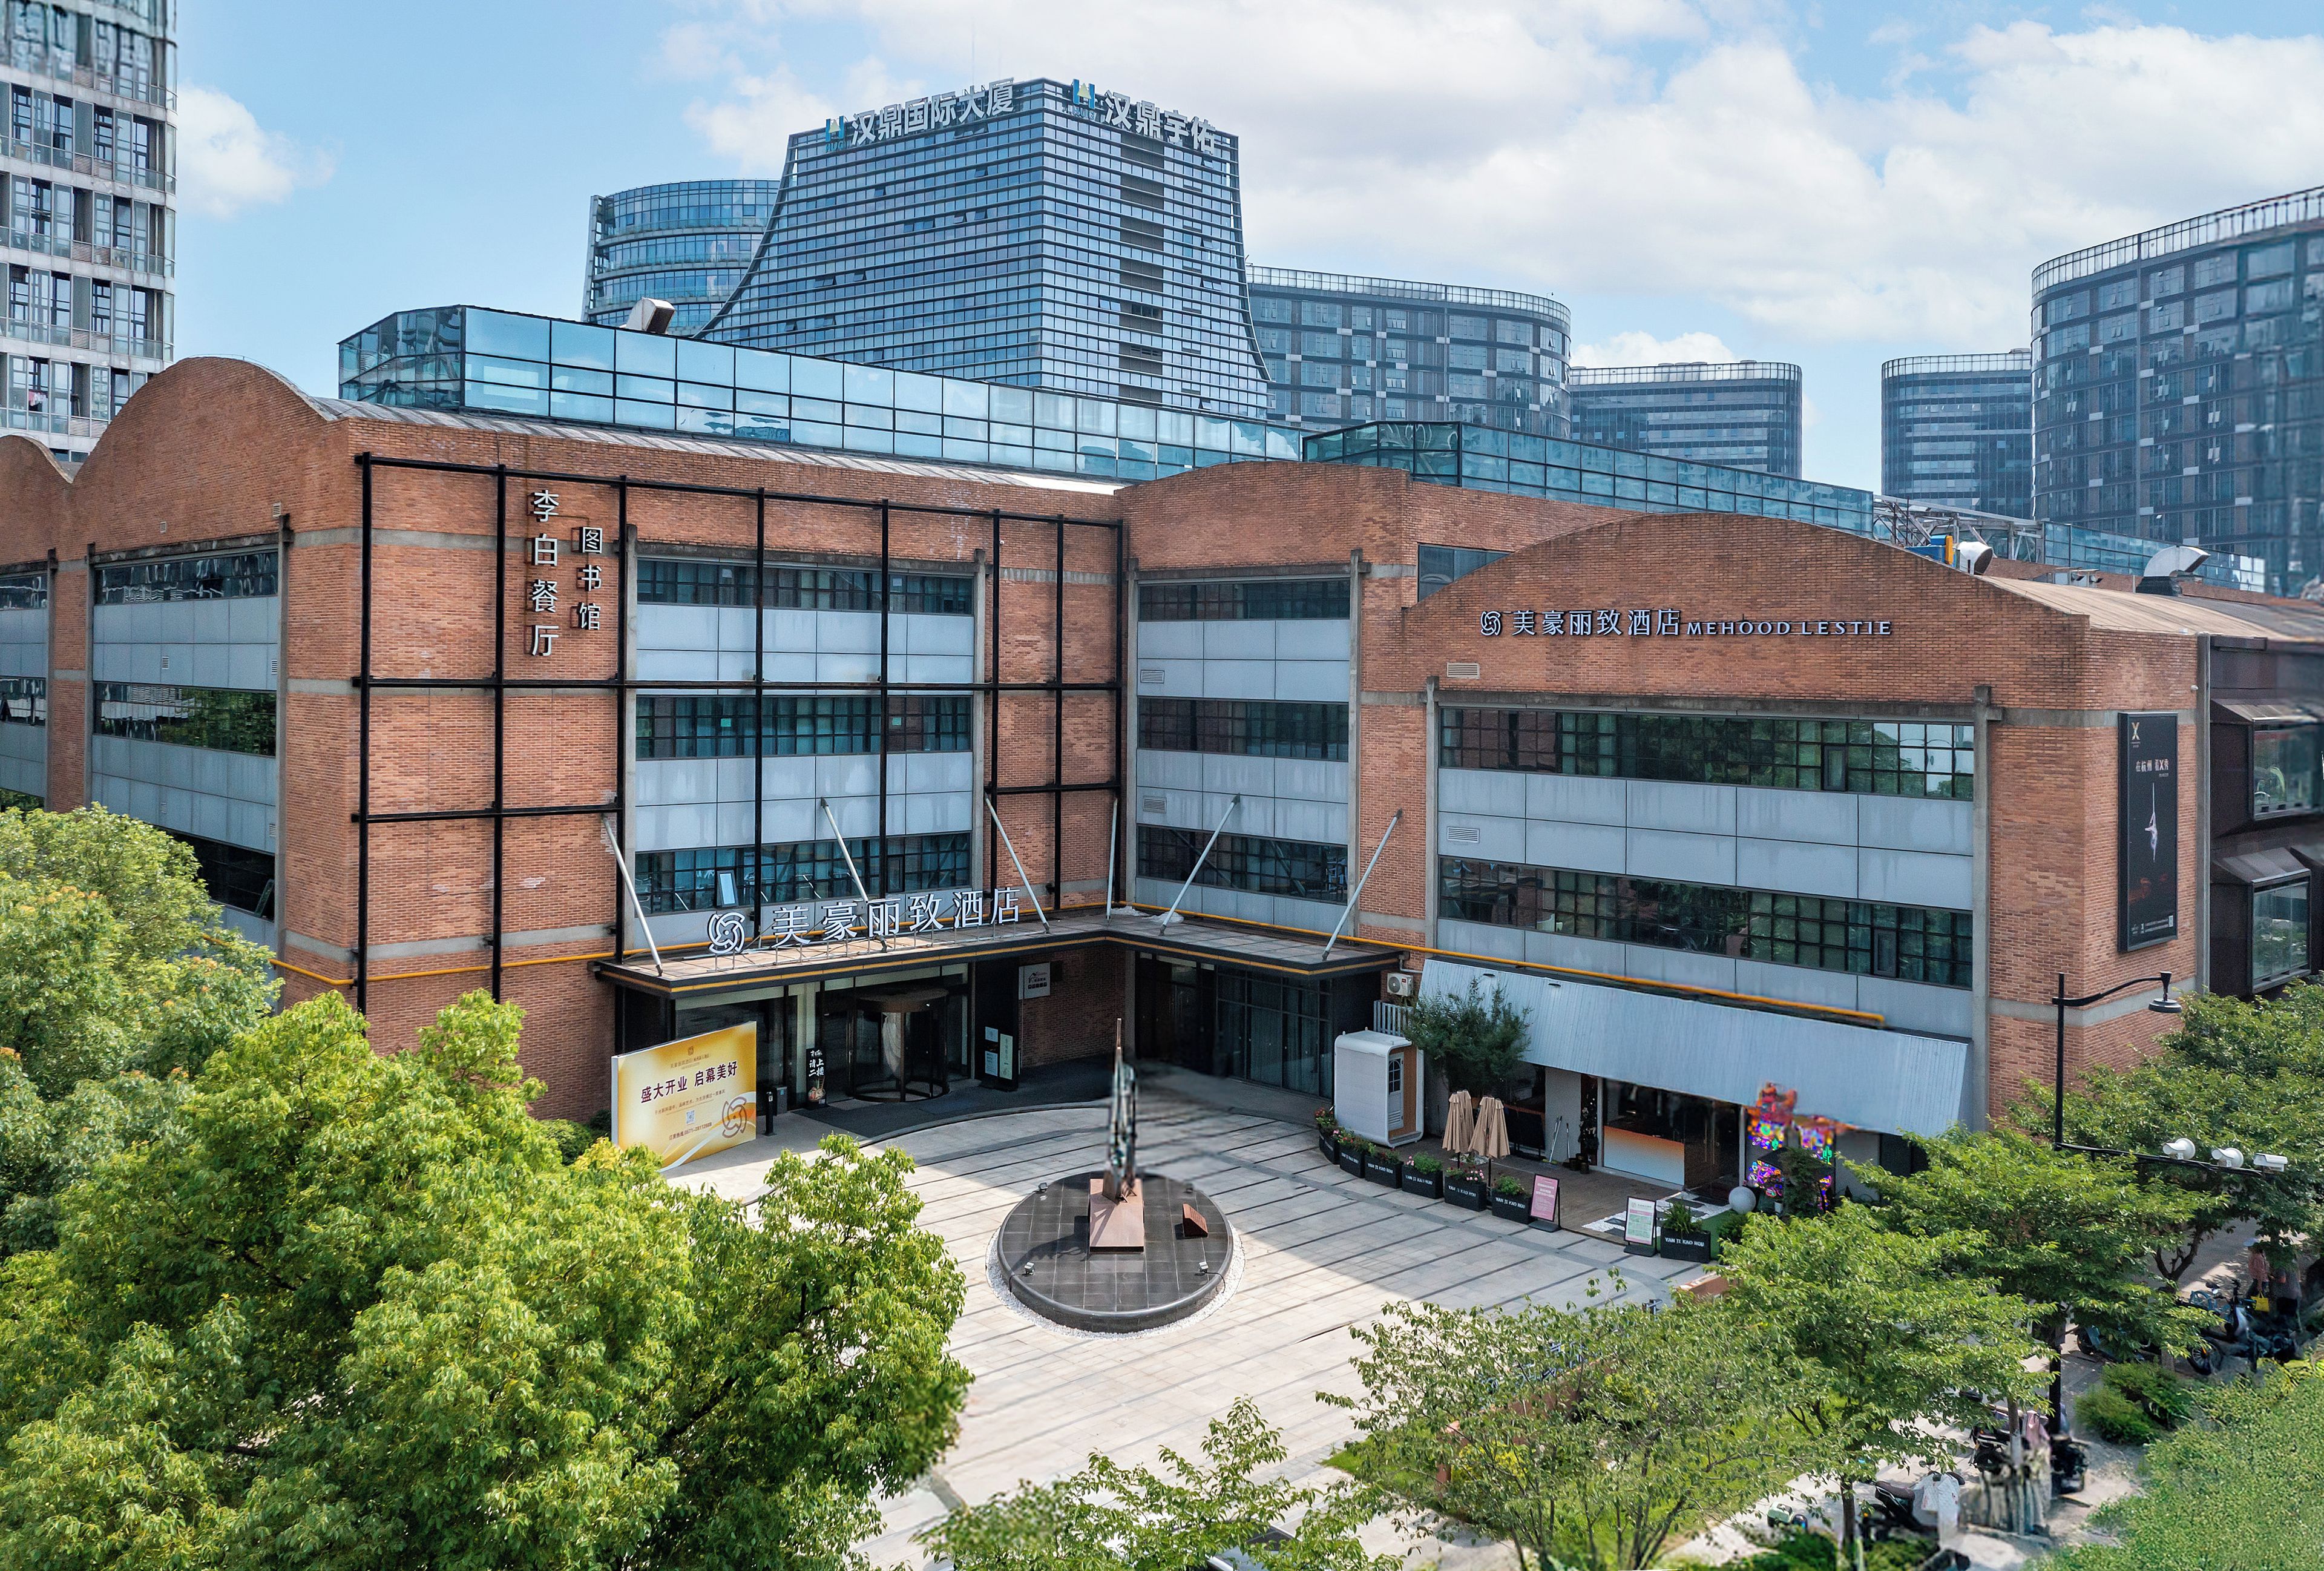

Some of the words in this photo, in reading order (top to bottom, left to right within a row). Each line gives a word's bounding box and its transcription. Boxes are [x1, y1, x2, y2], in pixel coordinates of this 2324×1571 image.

[852, 77, 1015, 146] 汉鼎国际大厦
[1105, 89, 1216, 154] 汉鼎宇佑
[531, 489, 559, 656] 李白餐厅
[579, 527, 603, 630] 图书馆
[1512, 608, 1680, 636] 美豪丽致酒店
[1687, 621, 1791, 635] MEHOOD
[1802, 621, 1891, 635] LESTIE
[772, 886, 1021, 947] 美豪丽致酒店
[641, 1076, 688, 1104] 盛大开业
[694, 1061, 738, 1087] 启幕美好
